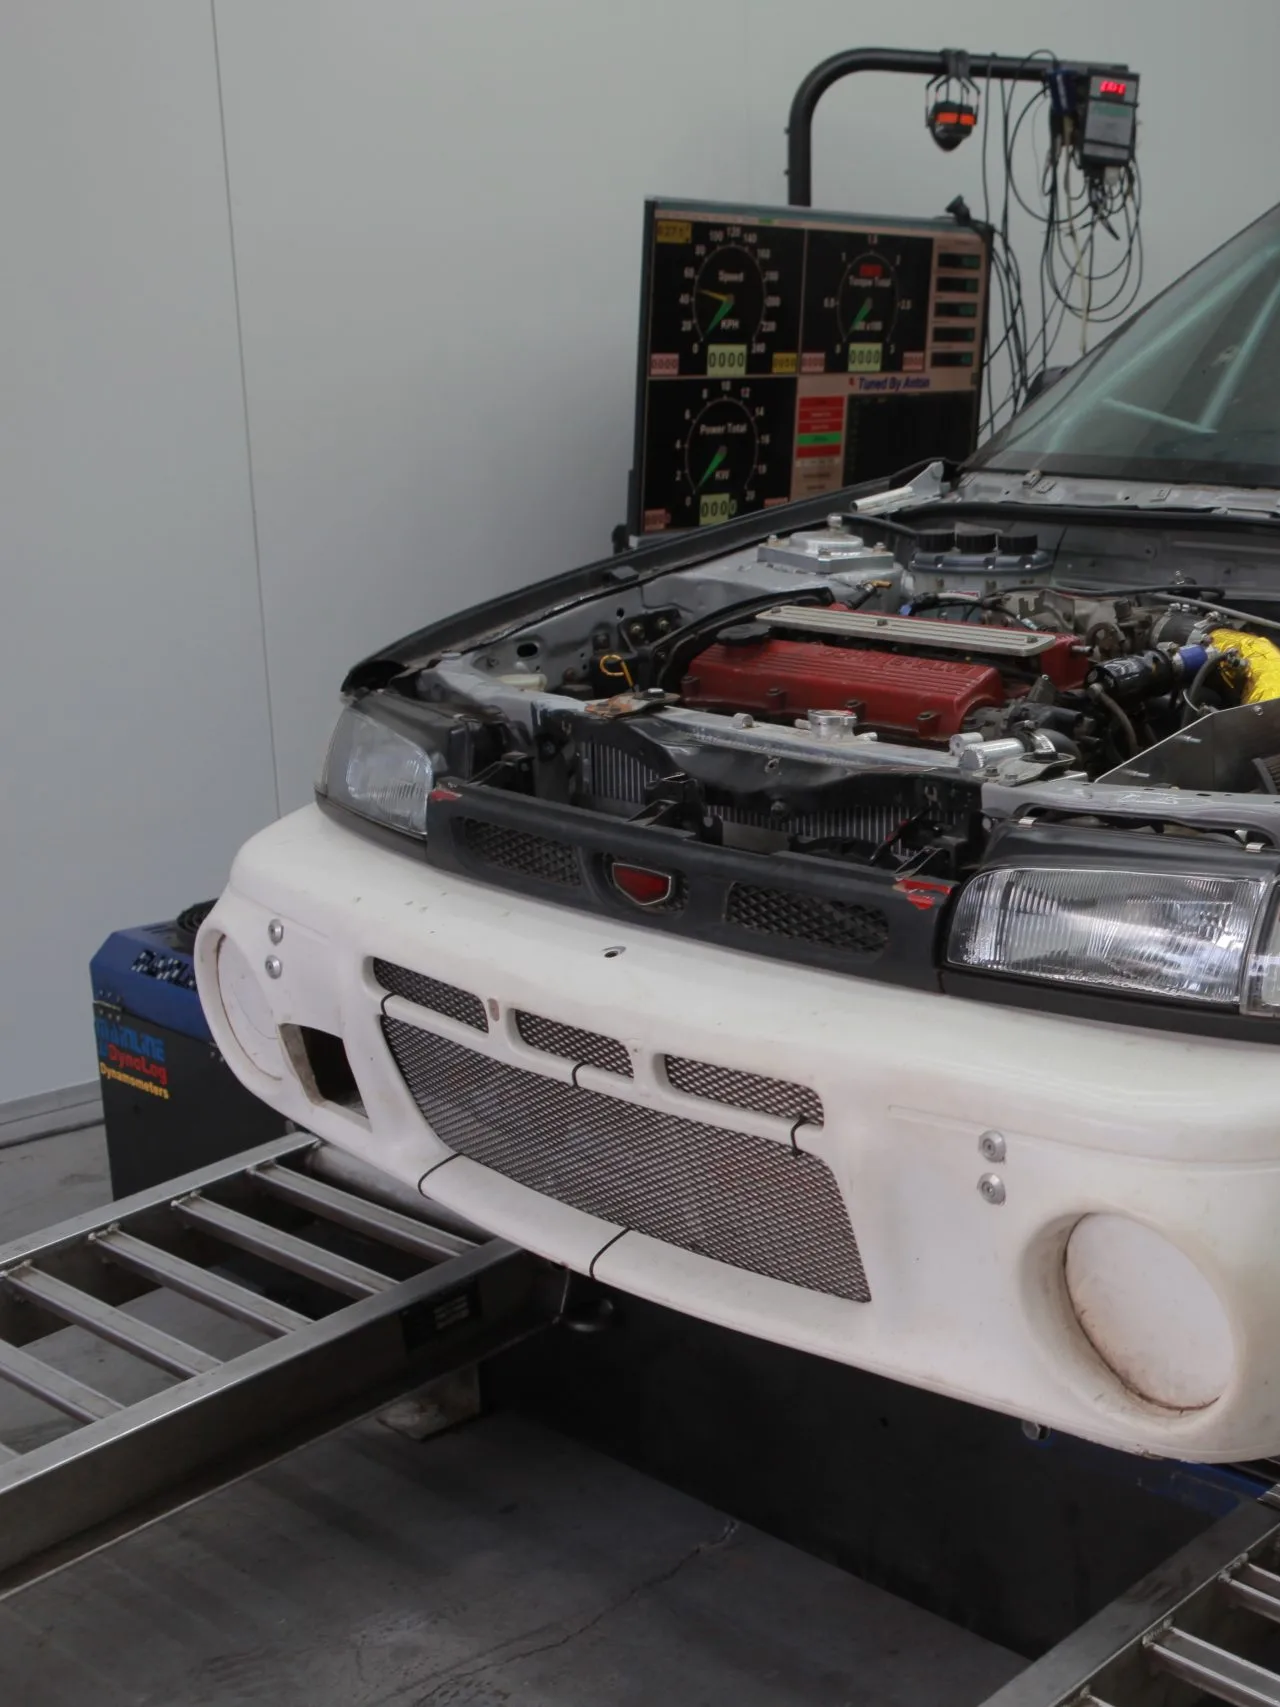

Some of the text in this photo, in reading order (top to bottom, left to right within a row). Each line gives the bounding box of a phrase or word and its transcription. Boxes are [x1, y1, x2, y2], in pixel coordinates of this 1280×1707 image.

[718, 269, 745, 284] Speed
[720, 318, 740, 331] KPH
[709, 352, 745, 367] 0000
[849, 350, 880, 364] 0000
[699, 422, 748, 436] Power Total
[714, 469, 730, 481] KW
[701, 499, 738, 518] 0000
